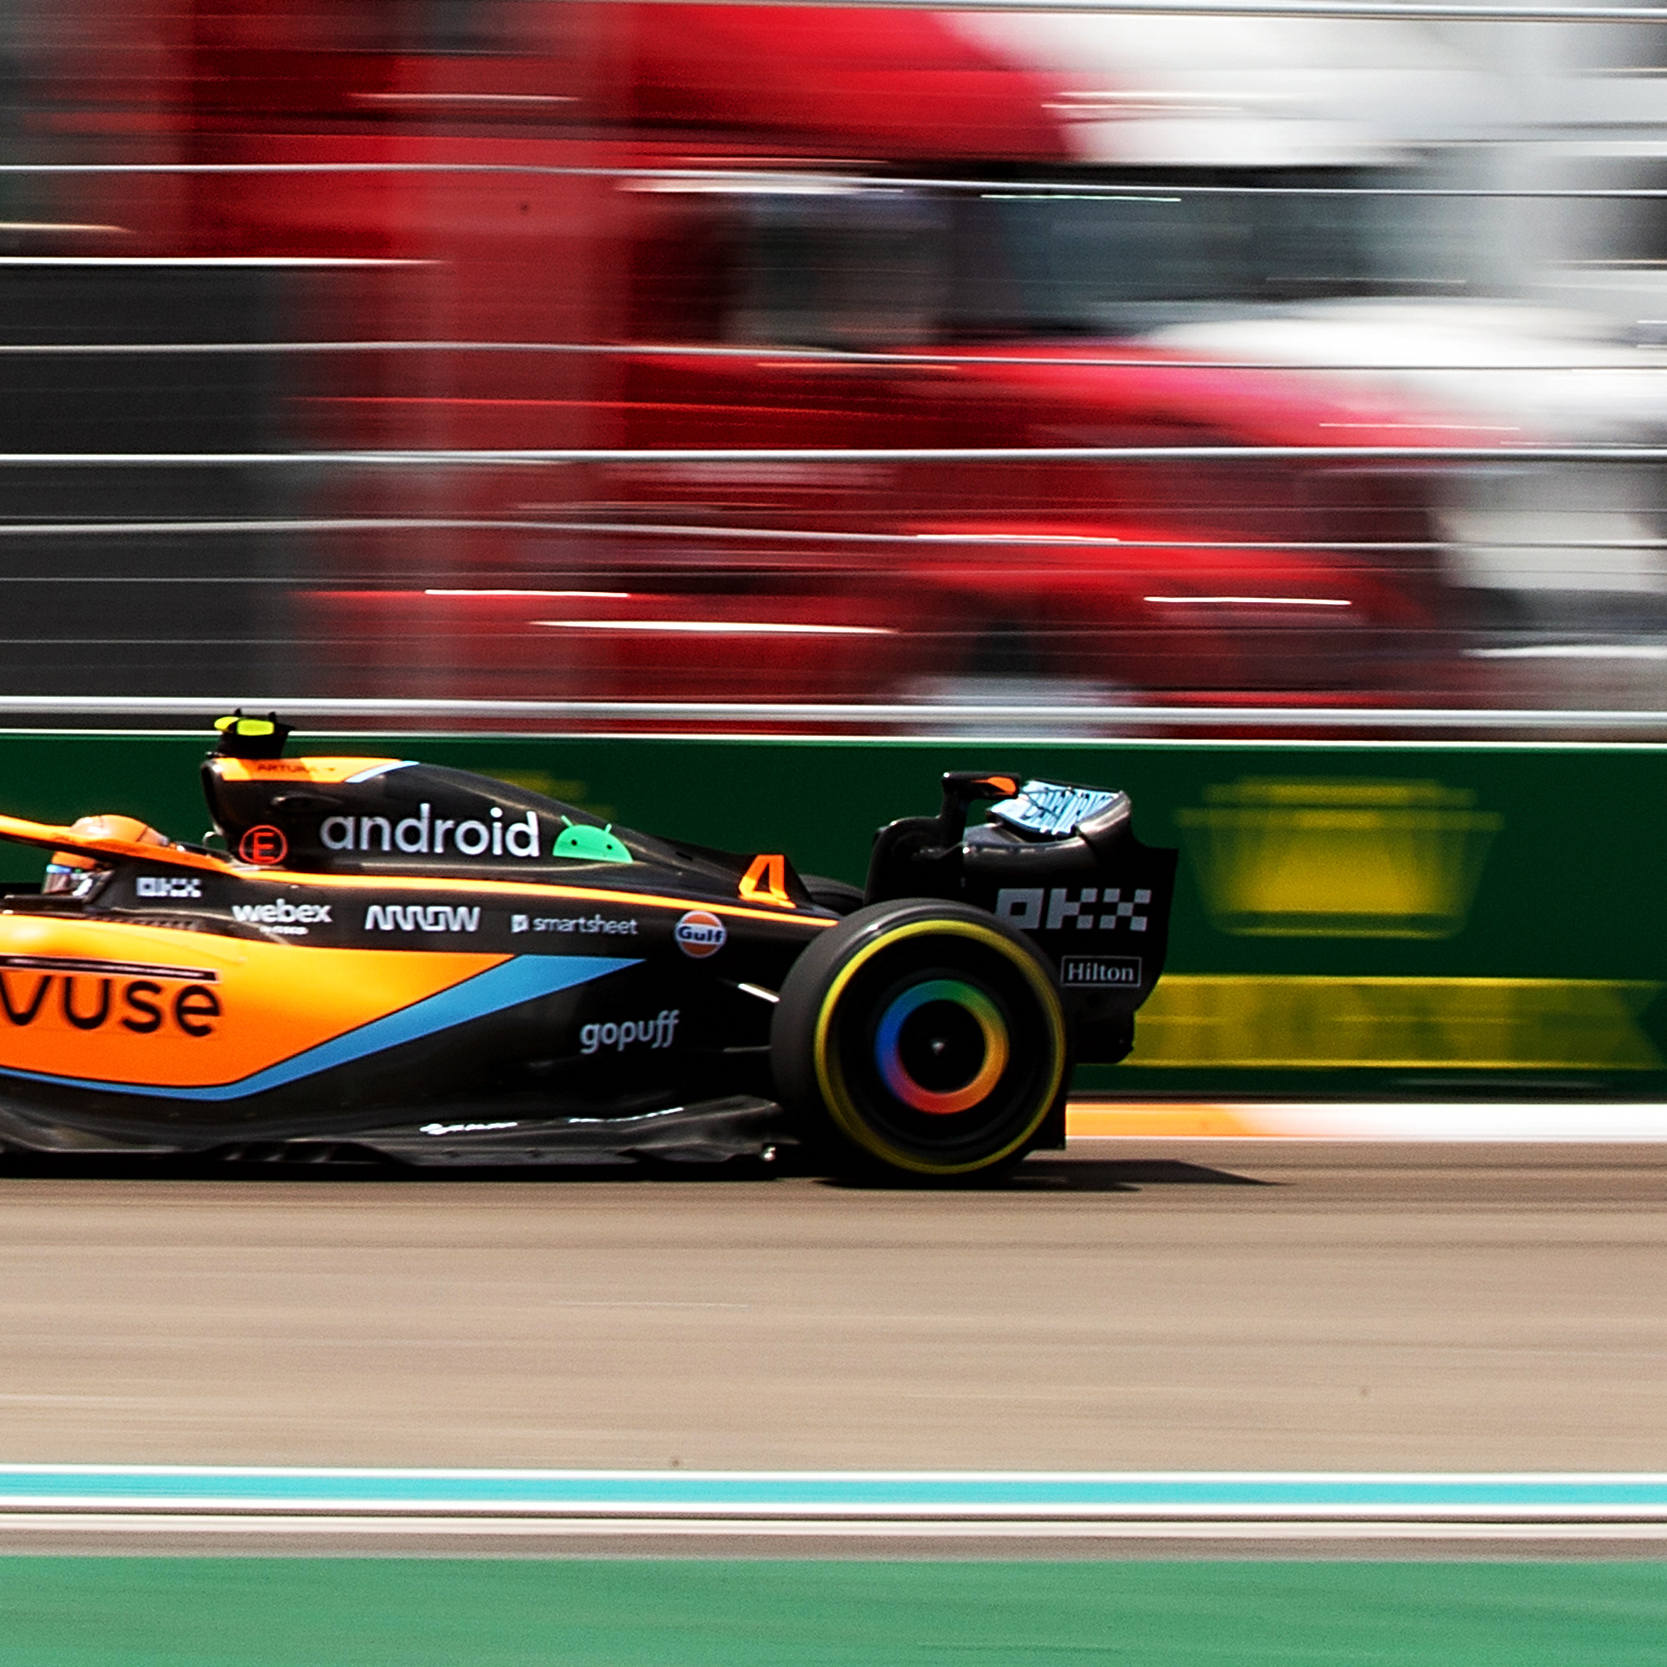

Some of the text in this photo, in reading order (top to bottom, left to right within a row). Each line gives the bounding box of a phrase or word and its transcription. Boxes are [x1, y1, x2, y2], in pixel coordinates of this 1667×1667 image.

[320, 803, 540, 859] android
[738, 854, 797, 908] 4
[232, 898, 332, 923] webex
[533, 914, 638, 934] smartsheet
[995, 888, 1152, 931] OKX
[679, 925, 725, 943] Gulf
[1067, 962, 1135, 982] Hilton
[579, 1010, 680, 1054] gopuff
